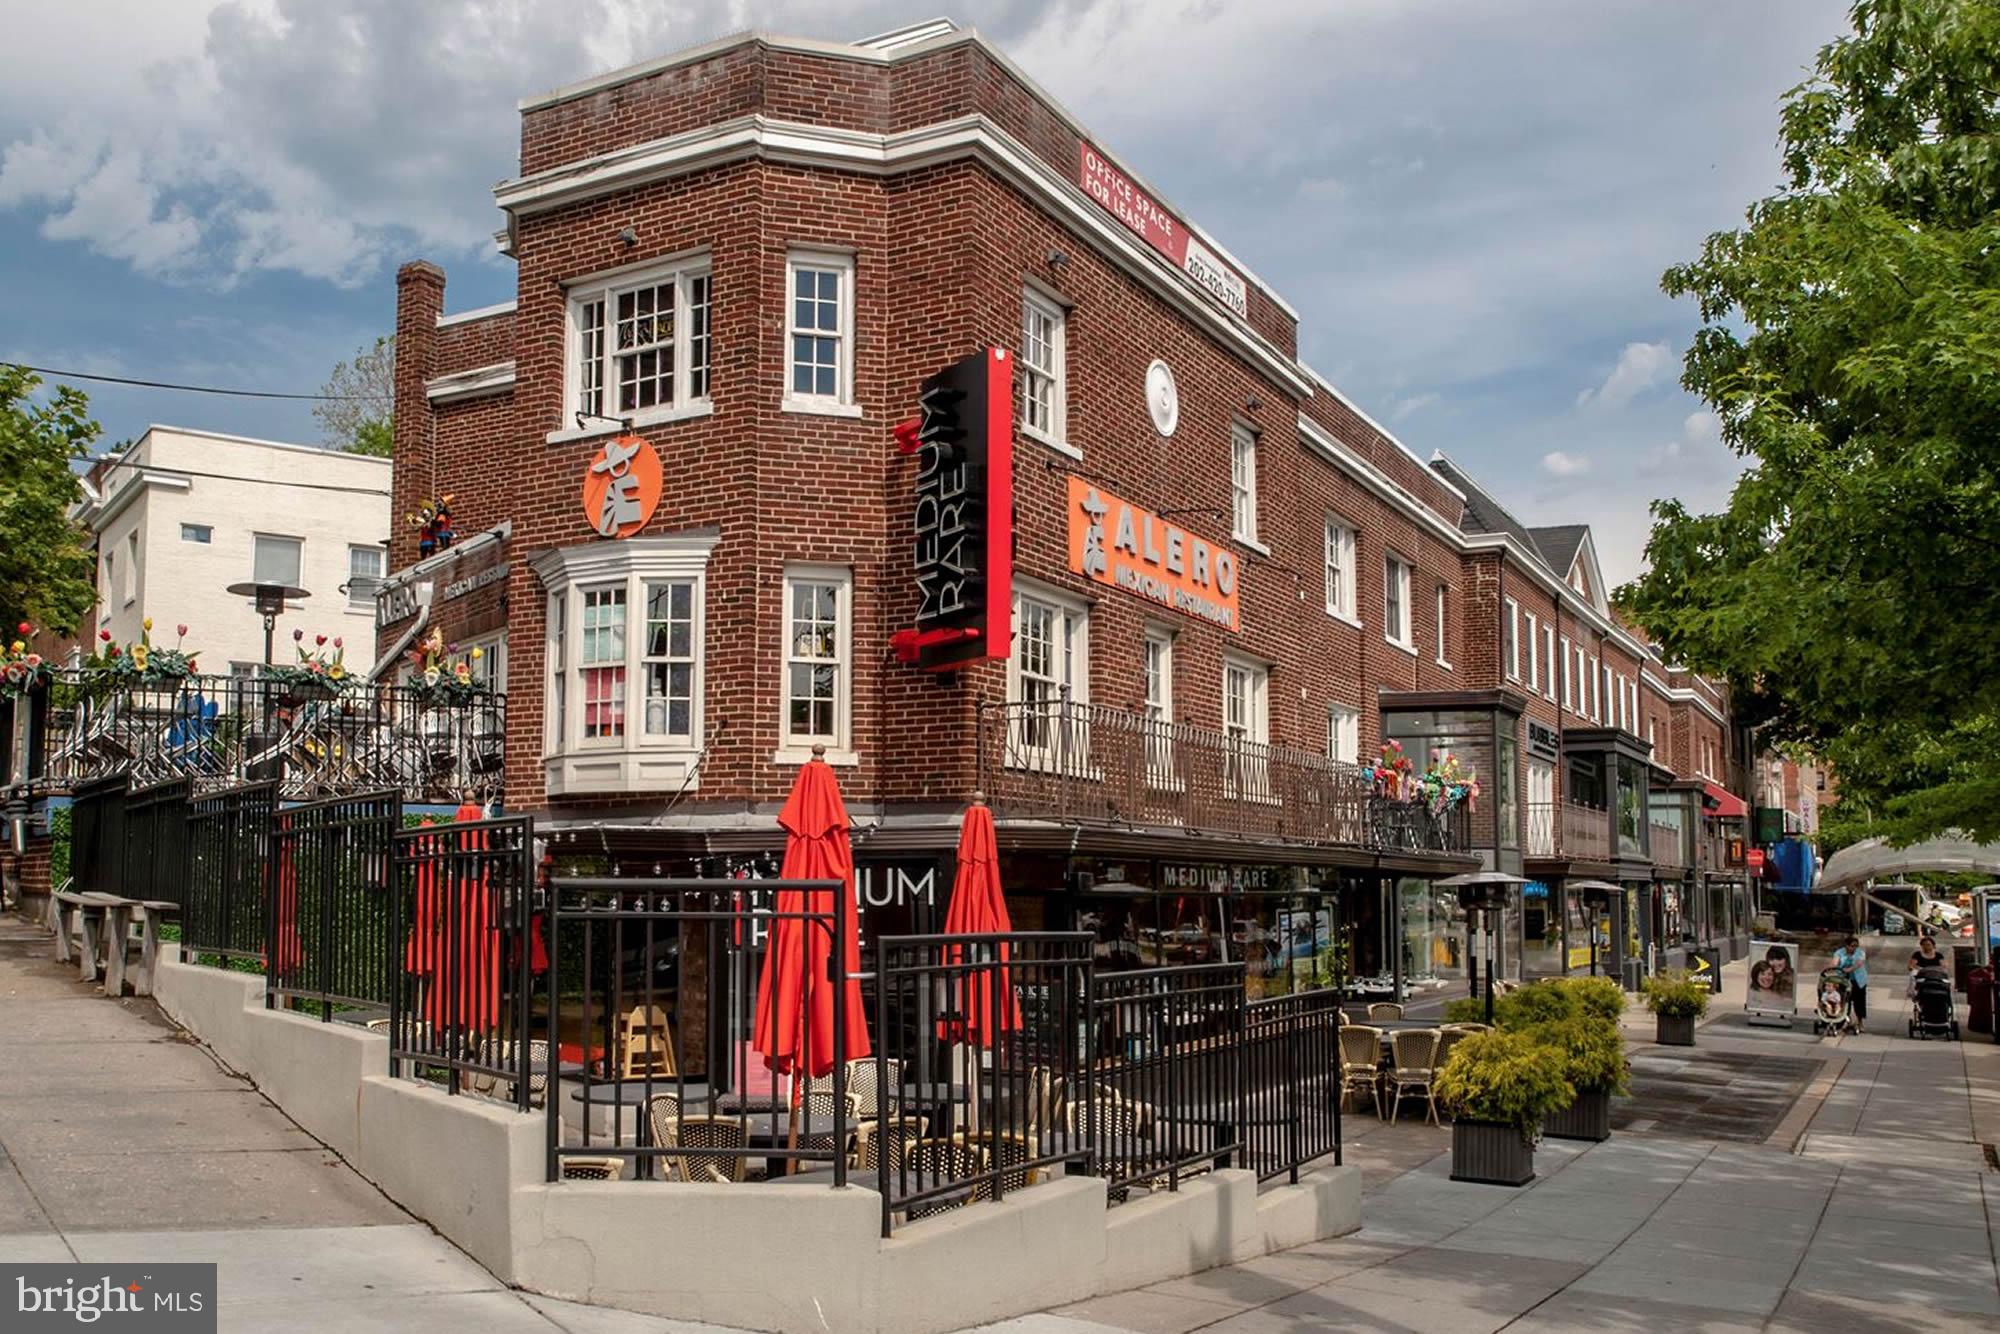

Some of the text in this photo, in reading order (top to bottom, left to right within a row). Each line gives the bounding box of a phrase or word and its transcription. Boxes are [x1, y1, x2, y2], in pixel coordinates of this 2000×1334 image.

[1085, 152, 1172, 236] OFFICE SPACE
[1085, 174, 1146, 236] FOR LEASE
[915, 387, 940, 621] MEDIUM
[940, 462, 967, 615] RARE
[1114, 504, 1233, 596] ALERO
[1164, 867, 1268, 888] MEDIUM RARE
